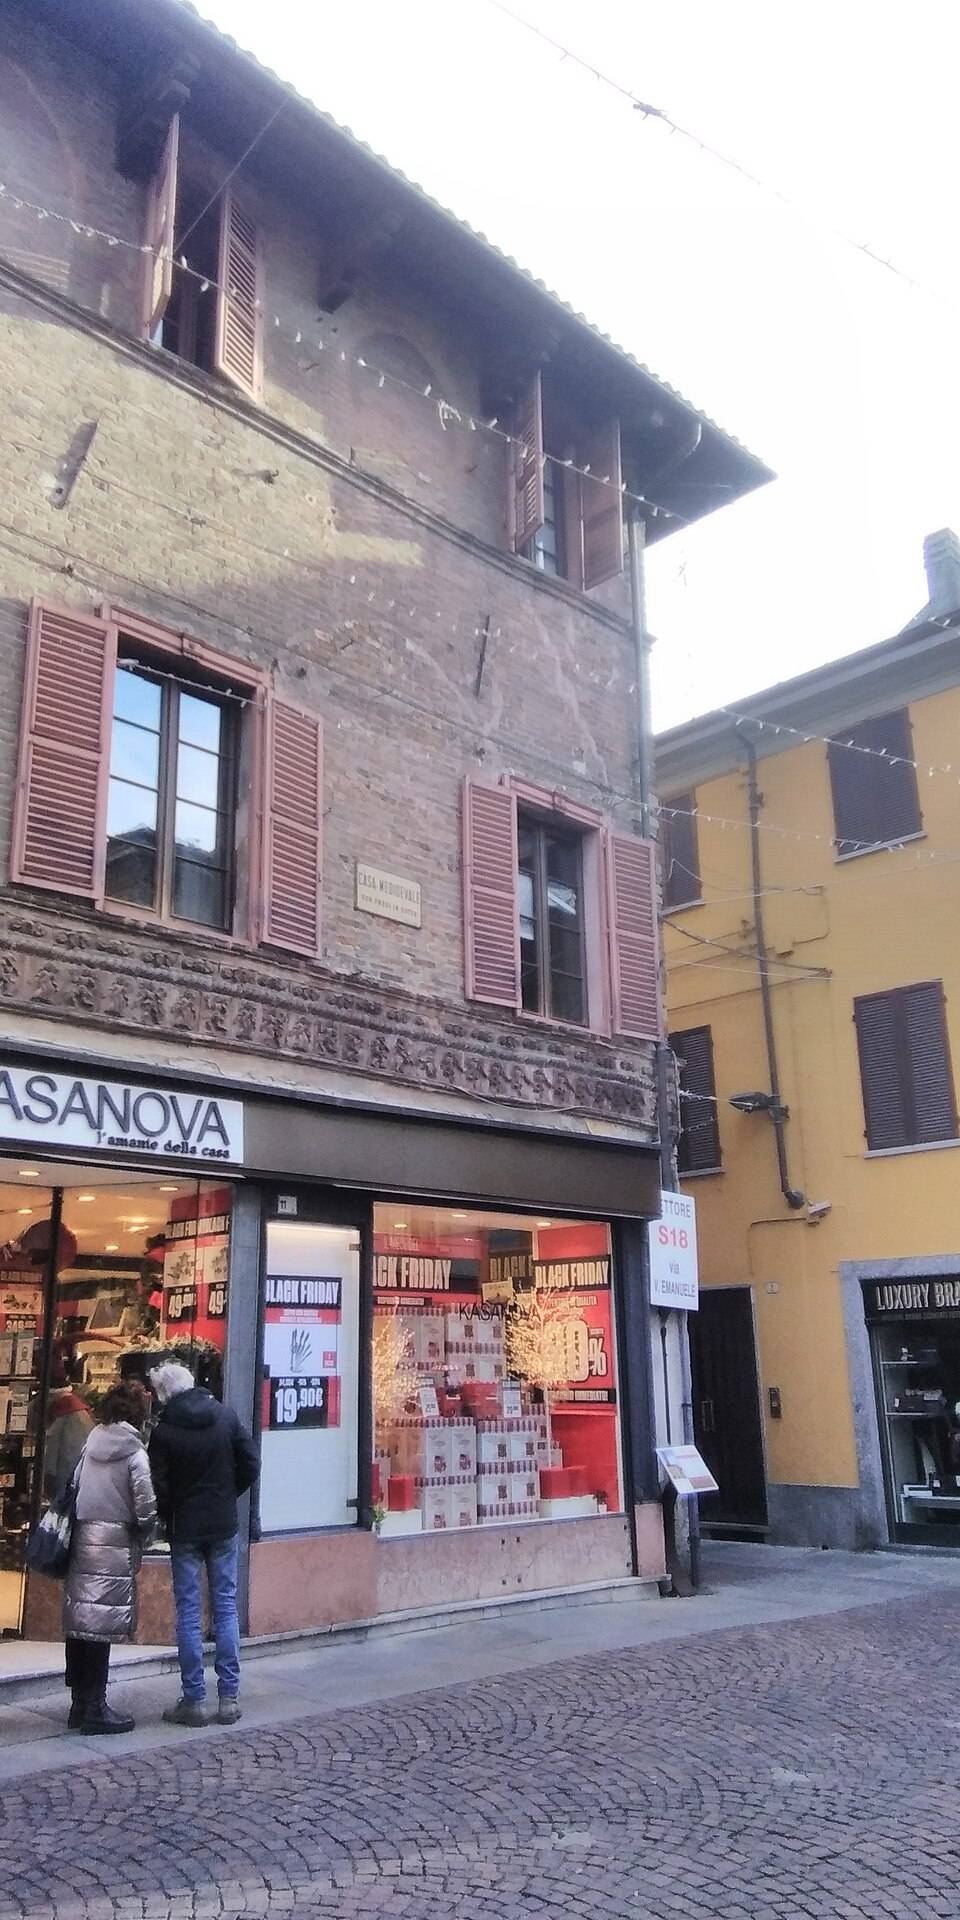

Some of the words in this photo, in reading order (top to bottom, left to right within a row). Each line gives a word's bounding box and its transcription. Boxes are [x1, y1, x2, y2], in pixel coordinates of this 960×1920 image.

[358, 871, 376, 889] CASA
[97, 1131, 159, 1150] l'amante
[164, 1140, 197, 1155] della
[201, 1146, 230, 1159] casa
[658, 1226, 688, 1249] S18
[401, 1257, 452, 1290] FRIDAY
[535, 1264, 570, 1289] BLACK
[570, 1261, 609, 1287] FRIDAY
[300, 1280, 339, 1305] FRIDAY
[876, 1283, 930, 1311] LUXURY
[275, 1388, 324, 1424] 19,90€
